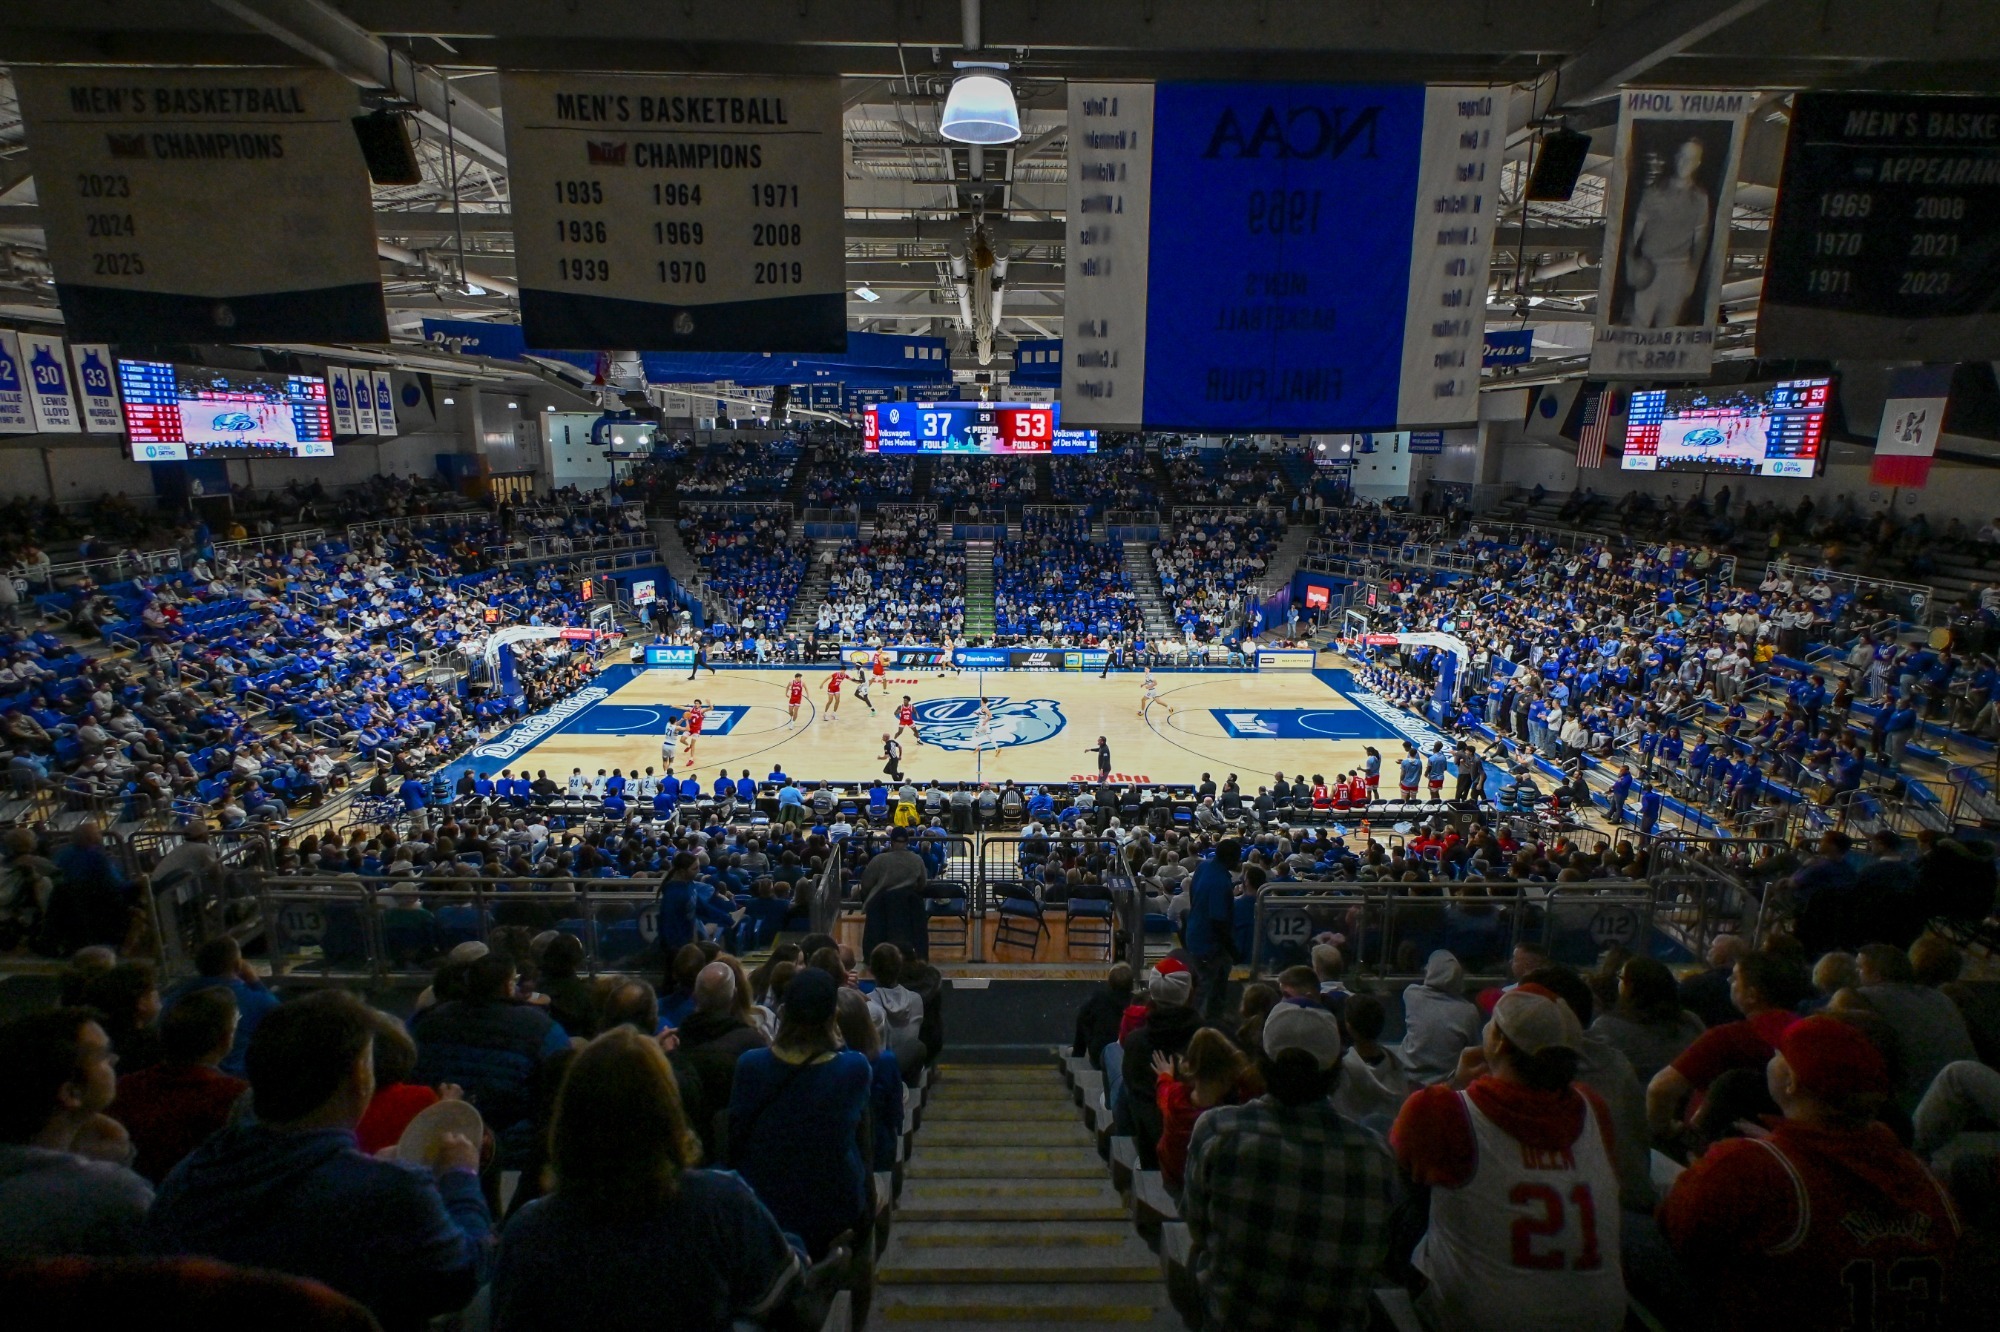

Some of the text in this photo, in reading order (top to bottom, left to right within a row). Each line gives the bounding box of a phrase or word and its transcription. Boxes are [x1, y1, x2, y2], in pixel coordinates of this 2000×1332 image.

[70, 87, 304, 113] MEN'S BASKETBALL
[557, 94, 787, 124] MEN'S BASKETBALL
[1843, 110, 1919, 137] MEN'S
[153, 134, 284, 160] CHAMPIONS
[635, 143, 761, 168] CHAMPIONS
[78, 174, 130, 198] 2023
[556, 182, 602, 204] 1935
[654, 184, 701, 206] 1964
[753, 184, 798, 207] 1971
[1820, 194, 1872, 217] 1969
[1914, 196, 1965, 220] 2008
[87, 214, 134, 237] 2024
[558, 221, 606, 243] 1936
[655, 222, 704, 245] 1969
[753, 224, 800, 246] 2008
[1816, 233, 1862, 256] 1970
[1910, 234, 1958, 256] 2021
[93, 254, 144, 275] 2025
[560, 259, 608, 281] 1939
[658, 261, 706, 283] 1970
[755, 262, 802, 284] 2019
[1808, 269, 1851, 292] 1971
[1898, 271, 1950, 294] 2023
[36, 366, 60, 385] 30
[86, 368, 106, 387] 33
[291, 384, 299, 393] 37
[315, 385, 324, 394] 53
[335, 388, 347, 401] 33
[357, 390, 368, 402] 13
[379, 391, 389, 403] 55
[1777, 391, 1788, 401] 37
[1812, 389, 1824, 400] 53
[42, 397, 67, 406] LEWIS
[43, 408, 69, 416] LLOYD
[923, 413, 951, 436] 37
[1016, 414, 1046, 437] 53
[1053, 430, 1084, 438] Volkswagen
[657, 650, 692, 660] FMH
[570, 779, 578, 787] 24
[1276, 916, 1304, 935] 112
[1508, 1182, 1601, 1271] 21
